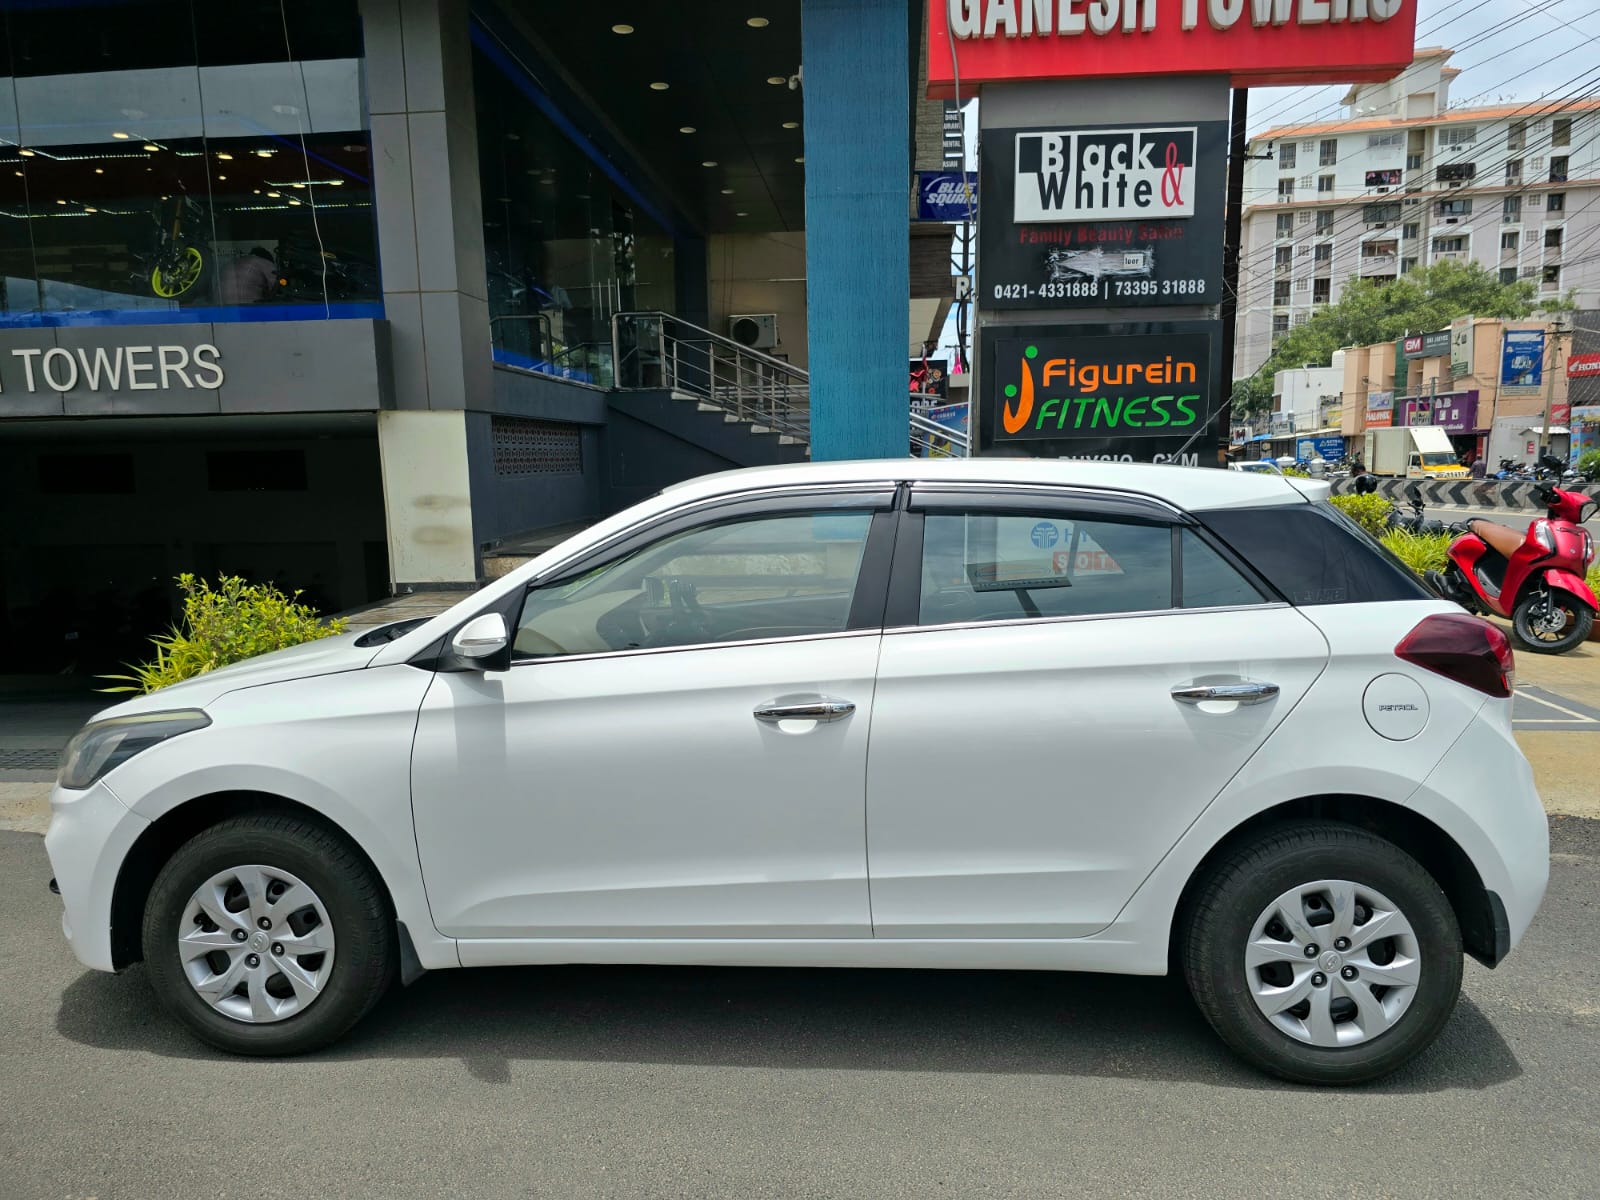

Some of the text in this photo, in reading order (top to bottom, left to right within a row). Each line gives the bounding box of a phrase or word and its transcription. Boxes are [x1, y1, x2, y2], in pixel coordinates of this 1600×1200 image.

[1041, 133, 1156, 173] Black
[1037, 171, 1153, 211] White
[1161, 141, 1185, 208] &
[926, 192, 977, 207] SQUA
[1019, 227, 1073, 247] Family
[1077, 225, 1133, 244] Beauty
[1038, 282, 1099, 298] 4331888
[1115, 280, 1157, 296] 73395
[1162, 279, 1206, 295] 31888
[12, 343, 225, 393] TOWERS
[1043, 355, 1196, 393] Figurein
[1035, 394, 1201, 430] FITNESS
